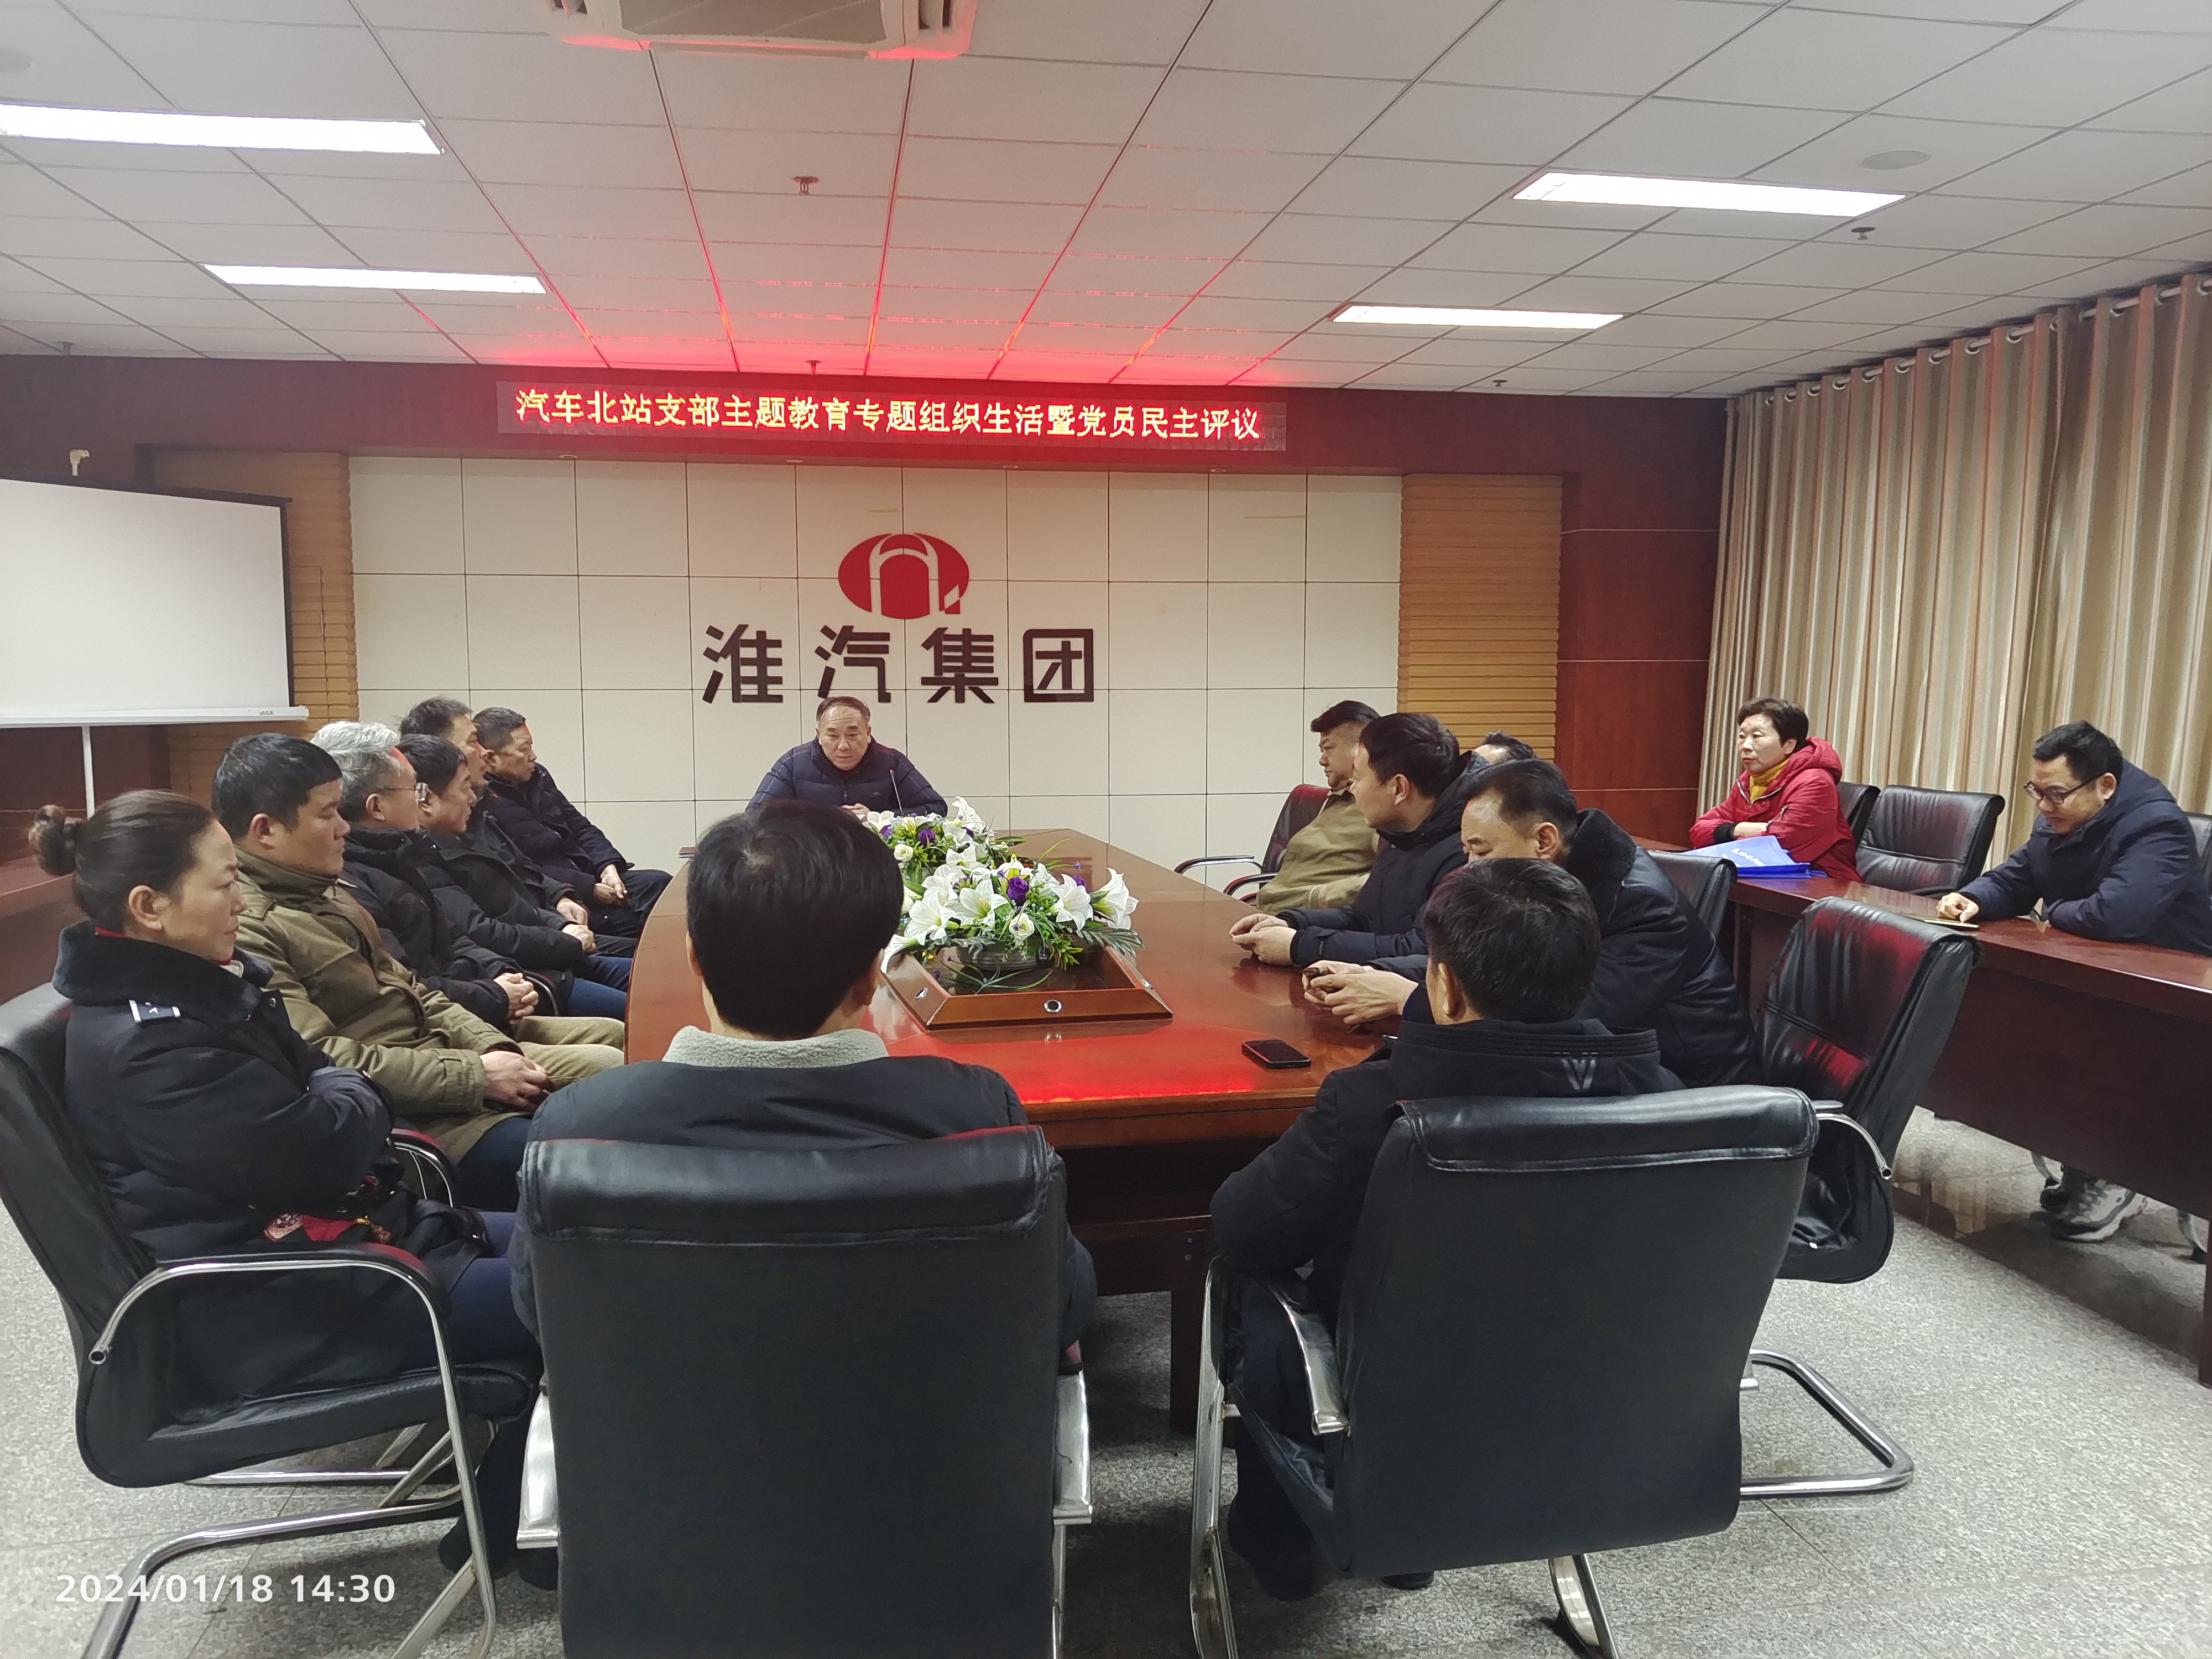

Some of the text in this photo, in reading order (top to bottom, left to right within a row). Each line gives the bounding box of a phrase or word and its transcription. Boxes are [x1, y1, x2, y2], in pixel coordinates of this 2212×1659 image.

[515, 388, 1260, 440] 汽车北站支部主题教育专题组织生活暨党员民主评议
[702, 624, 1094, 704] 淮汽集团
